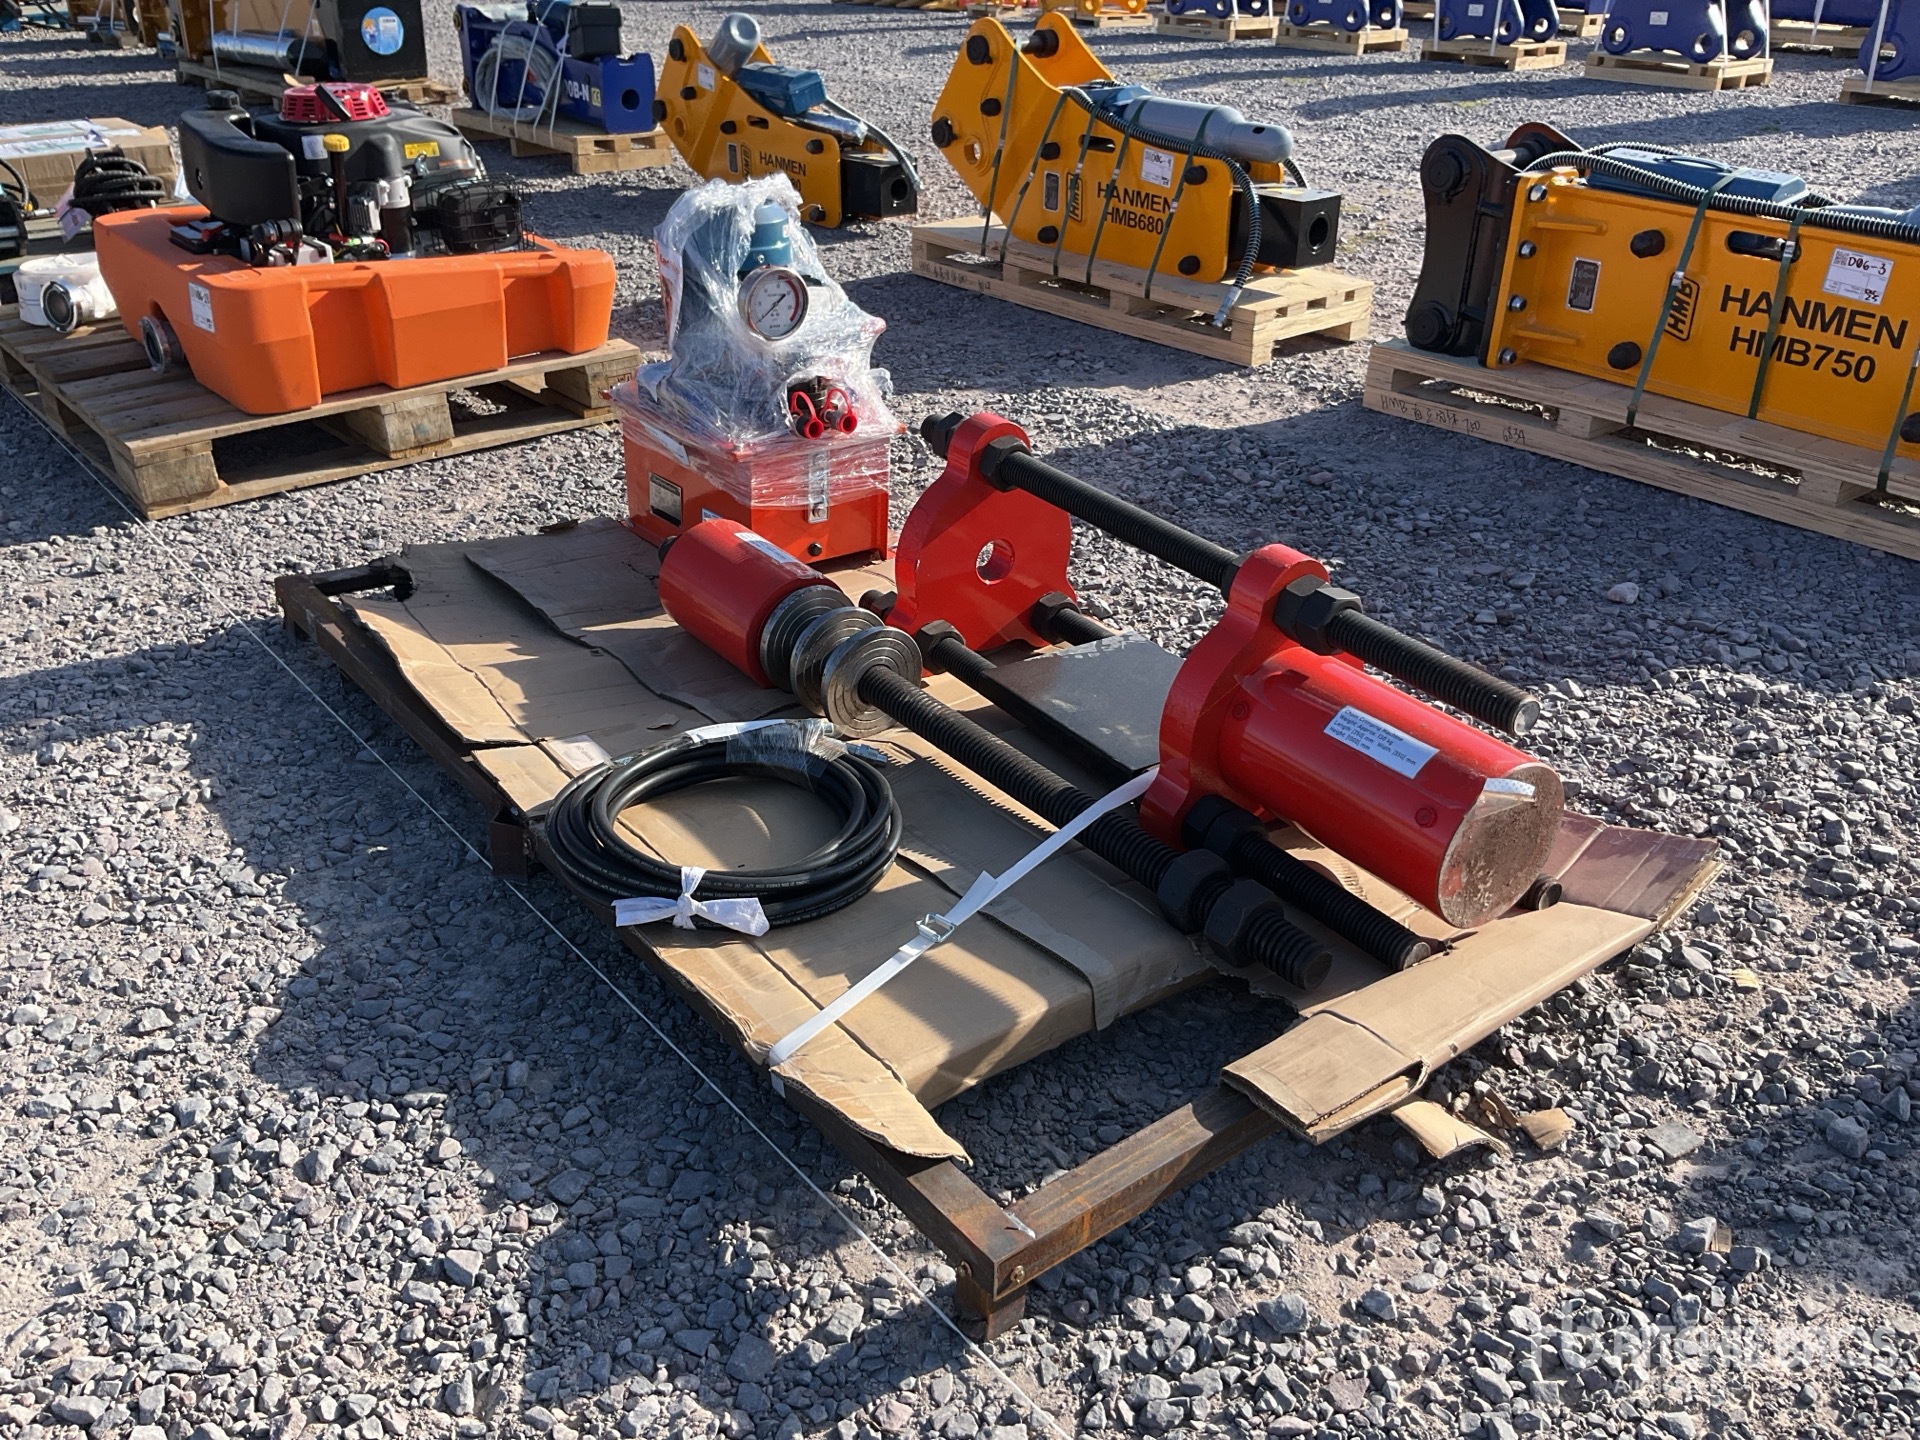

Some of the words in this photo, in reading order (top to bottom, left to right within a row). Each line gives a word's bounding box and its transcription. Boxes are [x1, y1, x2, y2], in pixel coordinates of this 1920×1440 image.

[759, 151, 806, 176] HANMEN
[1097, 182, 1174, 214] HANMEN
[1105, 207, 1164, 235] HMB680
[1848, 256, 1887, 276] D06-3
[1719, 284, 1909, 350] HANMEN
[1729, 326, 1876, 383] HMB750
